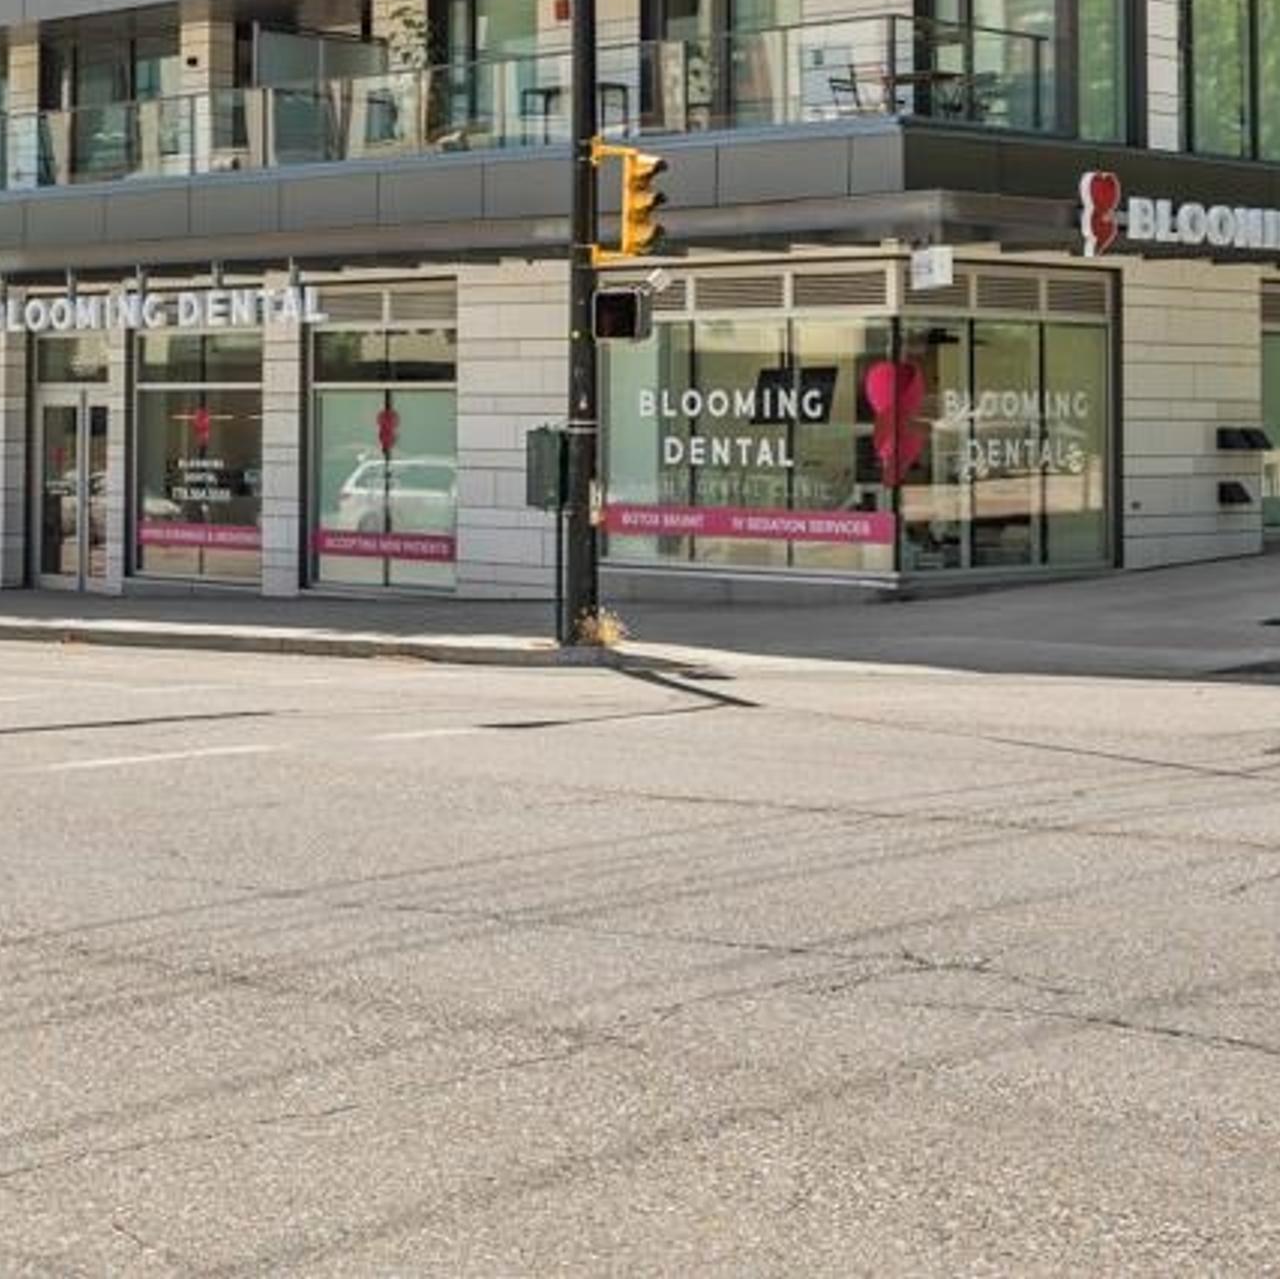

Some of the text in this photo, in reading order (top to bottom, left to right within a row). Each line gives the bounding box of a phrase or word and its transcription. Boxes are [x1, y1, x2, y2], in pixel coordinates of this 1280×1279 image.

[178, 286, 329, 327] DENTAL
[639, 390, 823, 417] BLOOMING
[943, 389, 1089, 418] BLOOMING
[664, 437, 794, 467] DENTAL
[967, 437, 1070, 468] DENTAL
